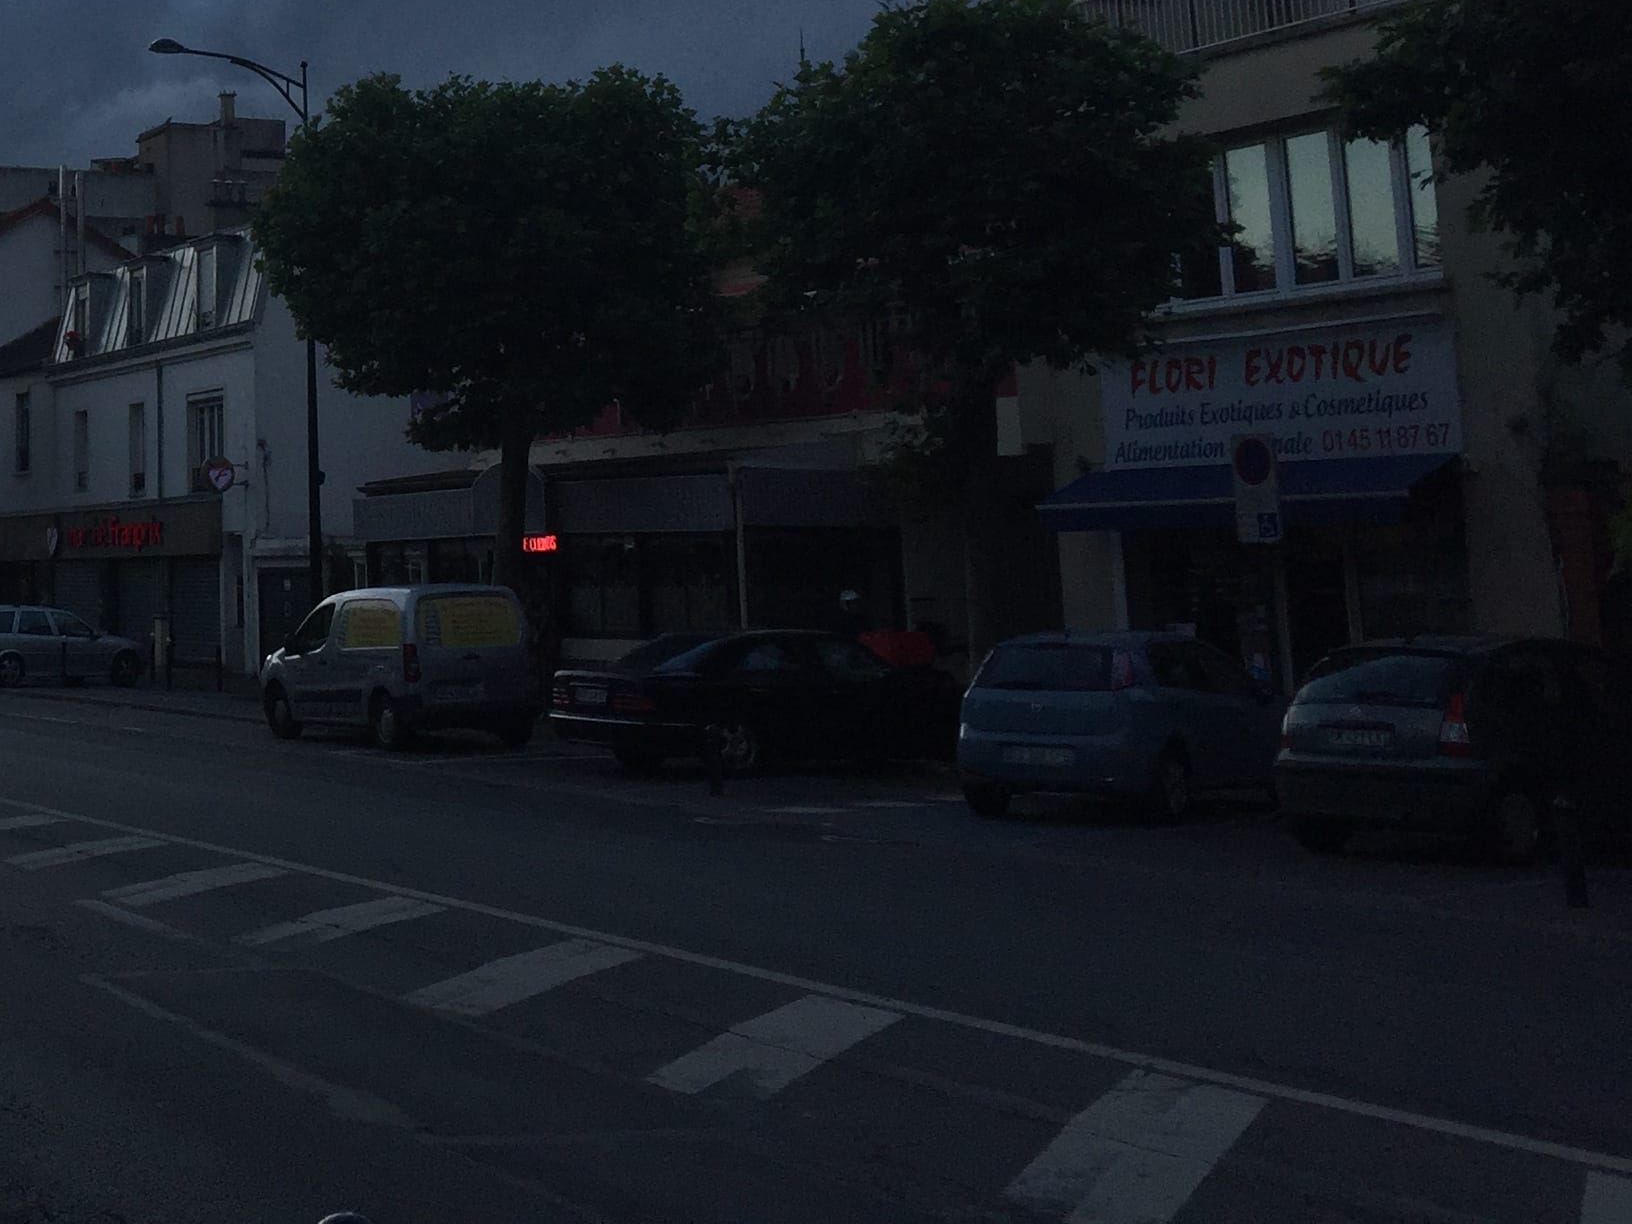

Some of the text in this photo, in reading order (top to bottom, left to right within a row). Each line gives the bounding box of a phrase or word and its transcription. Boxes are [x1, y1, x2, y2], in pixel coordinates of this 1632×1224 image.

[1130, 333, 1412, 398] FLORI EXOTIQUE
[1124, 405, 1195, 431] Produits
[1199, 400, 1283, 428] Exotiques
[1114, 439, 1225, 465] Alimentation
